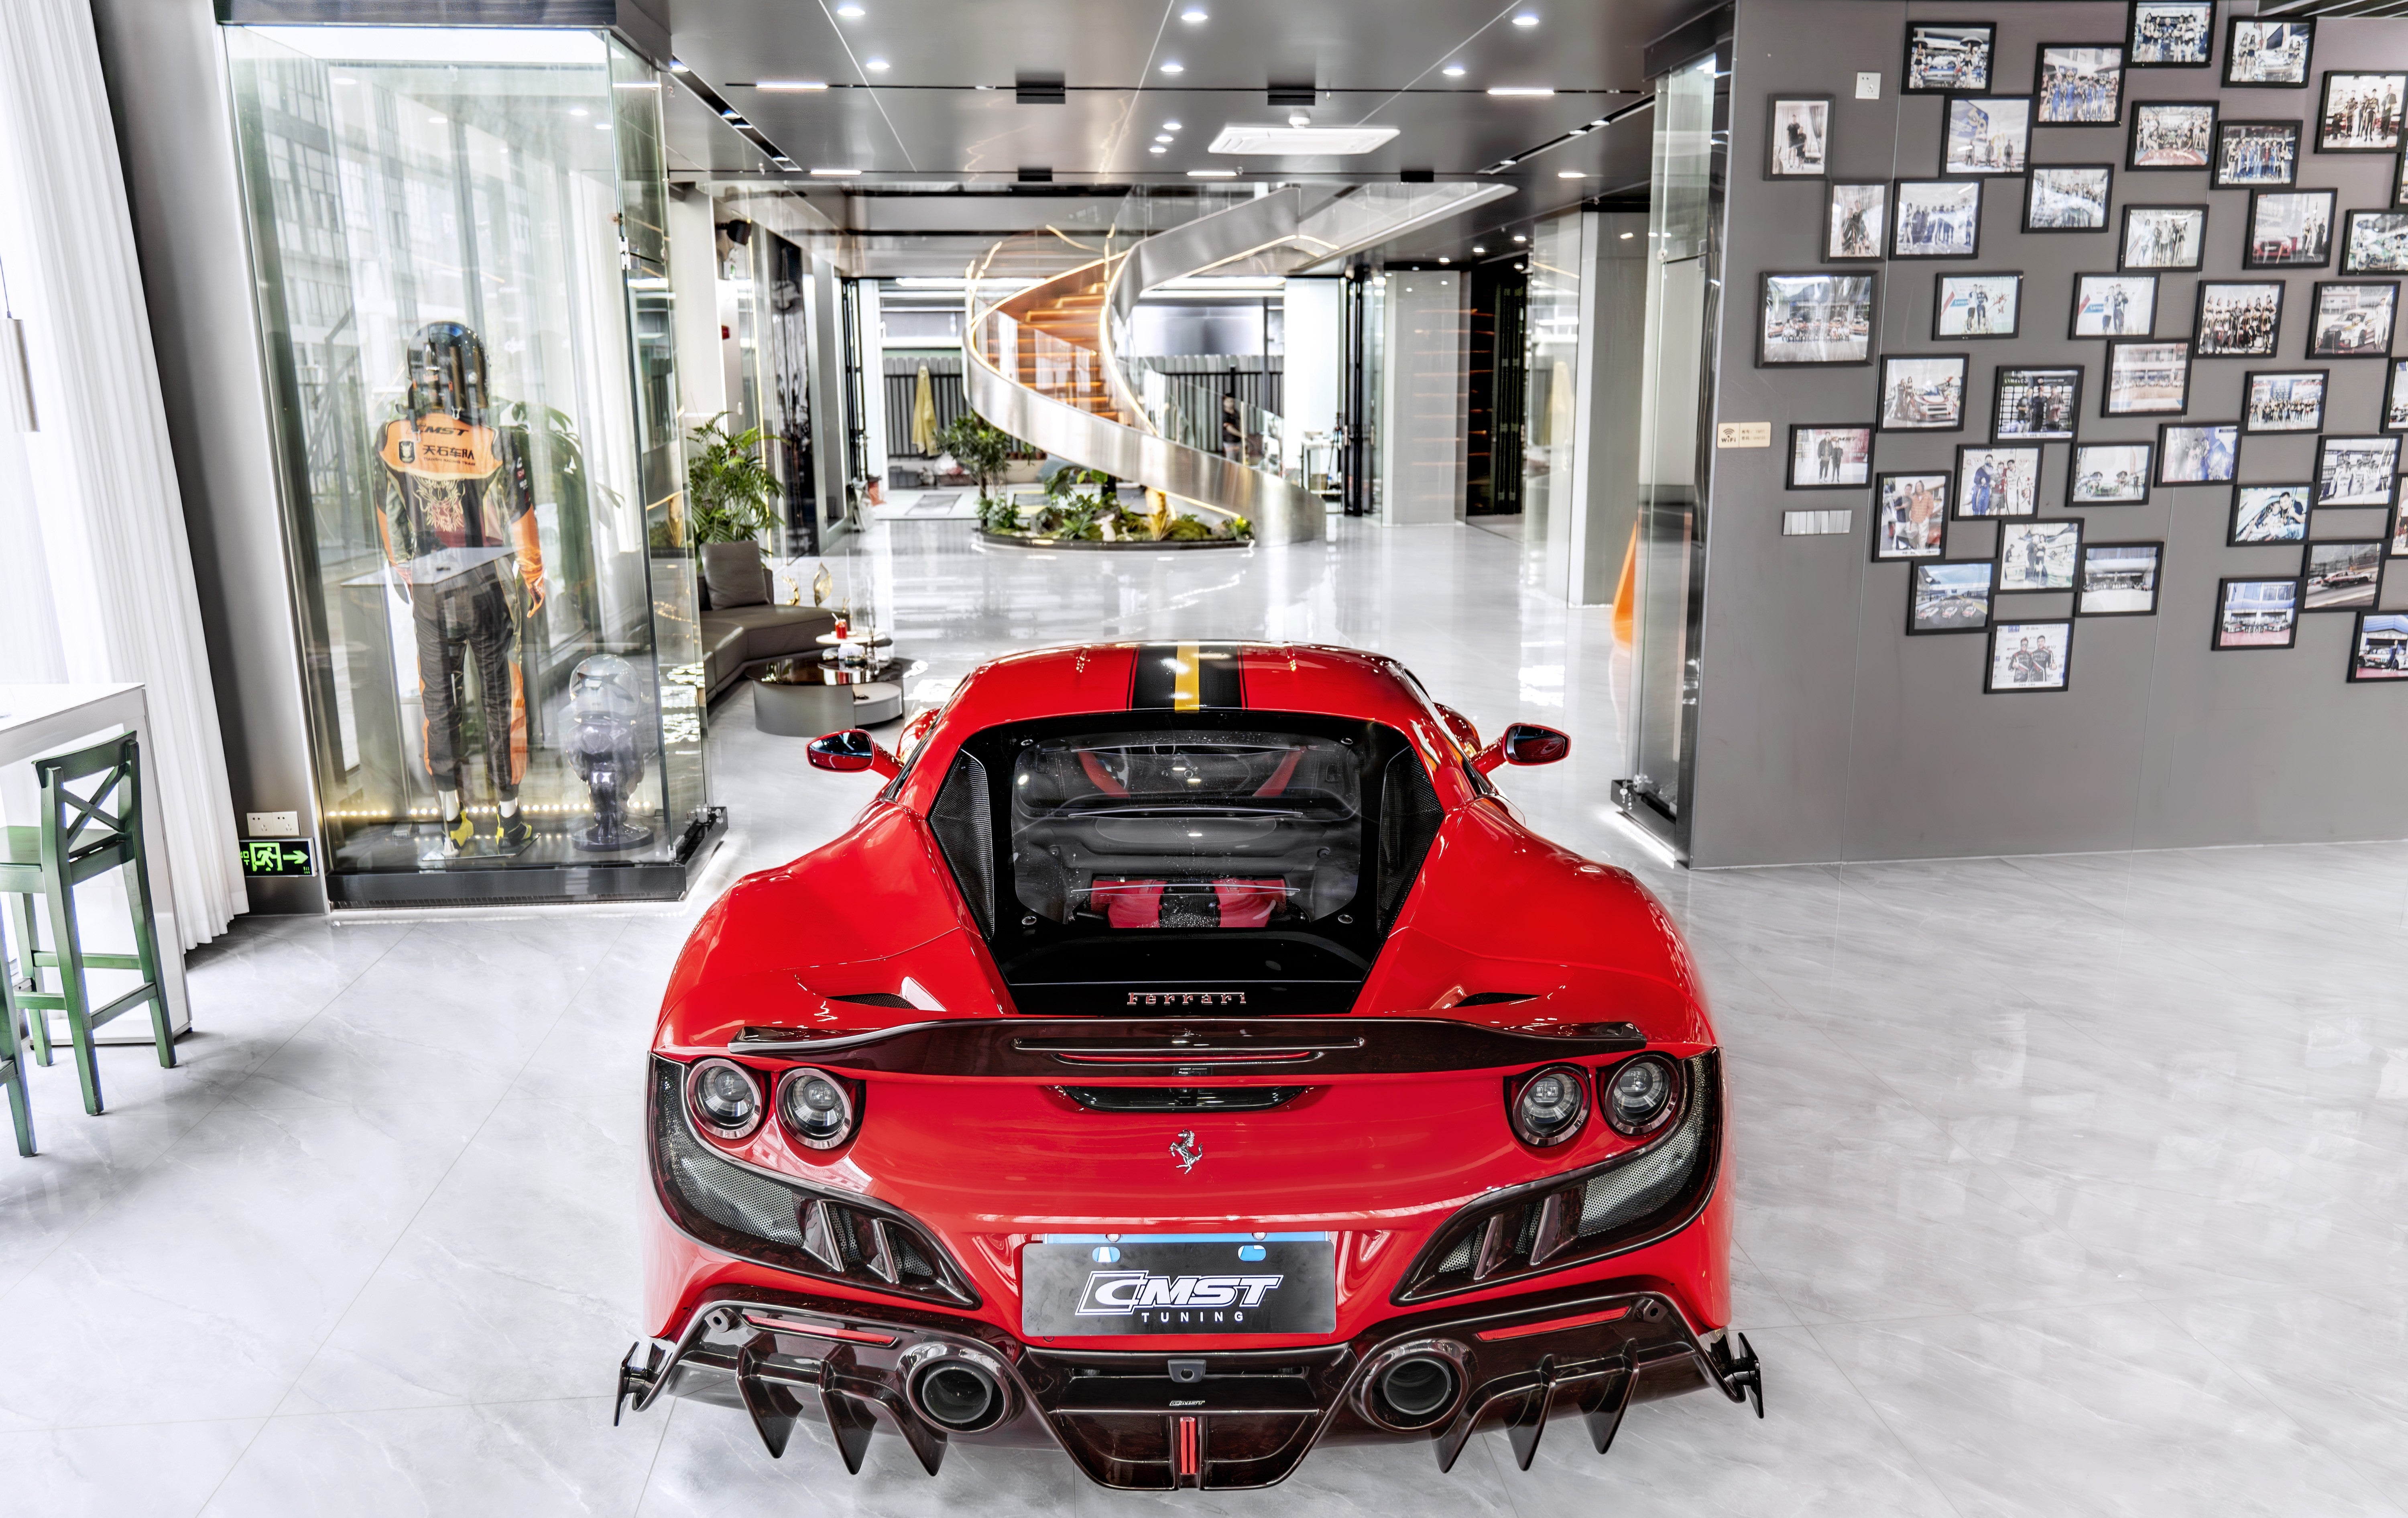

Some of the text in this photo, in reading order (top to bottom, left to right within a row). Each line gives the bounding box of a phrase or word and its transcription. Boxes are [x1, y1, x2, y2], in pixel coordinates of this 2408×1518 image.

[423, 444, 474, 460] 天石车队
[1127, 992, 1247, 1006] Ferrari
[1075, 1270, 1283, 1316] CMST
[1141, 1311, 1244, 1323] TUNING
